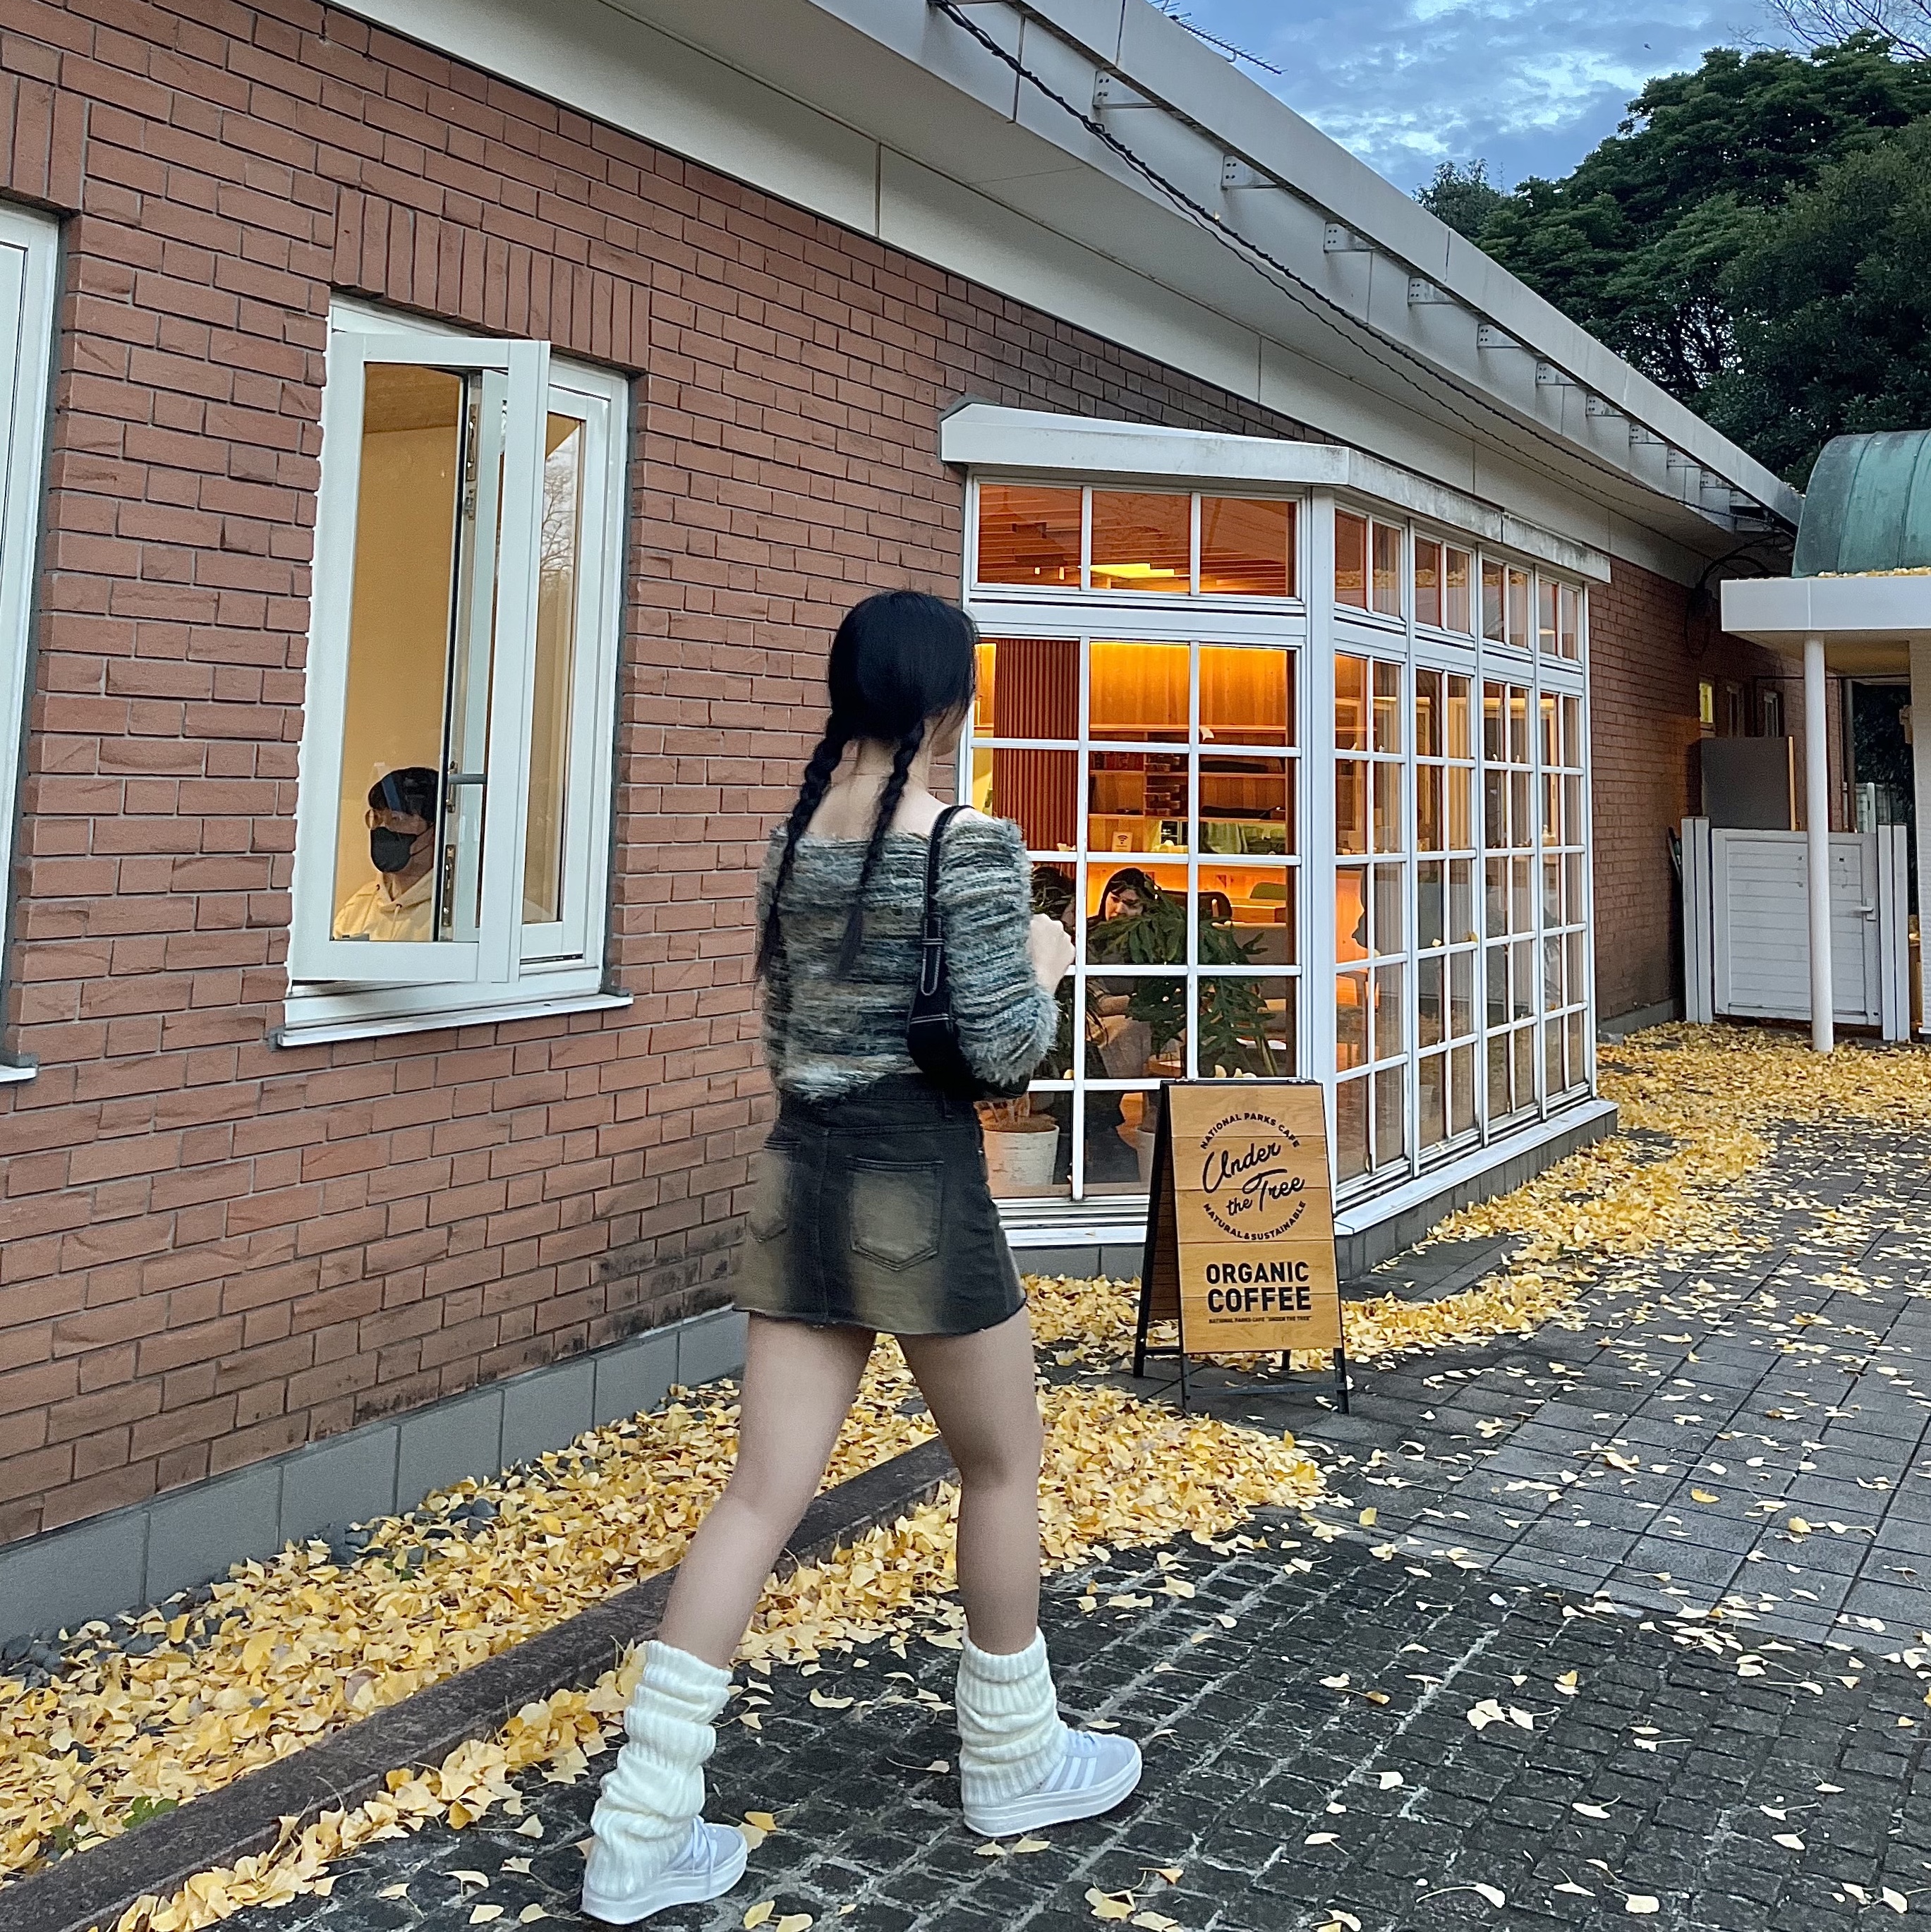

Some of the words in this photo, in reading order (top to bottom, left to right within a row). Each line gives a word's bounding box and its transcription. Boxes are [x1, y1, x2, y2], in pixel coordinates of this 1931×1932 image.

[1200, 1114, 1242, 1150] NATIONAL
[1244, 1112, 1276, 1126] PARKS
[1278, 1124, 1300, 1148] CAFE
[1202, 1142, 1281, 1193] Under
[1225, 1197, 1253, 1216] the
[1242, 1168, 1305, 1212] Tree
[1206, 1261, 1309, 1284] ORGANIC
[1208, 1286, 1312, 1313] COFFEE
